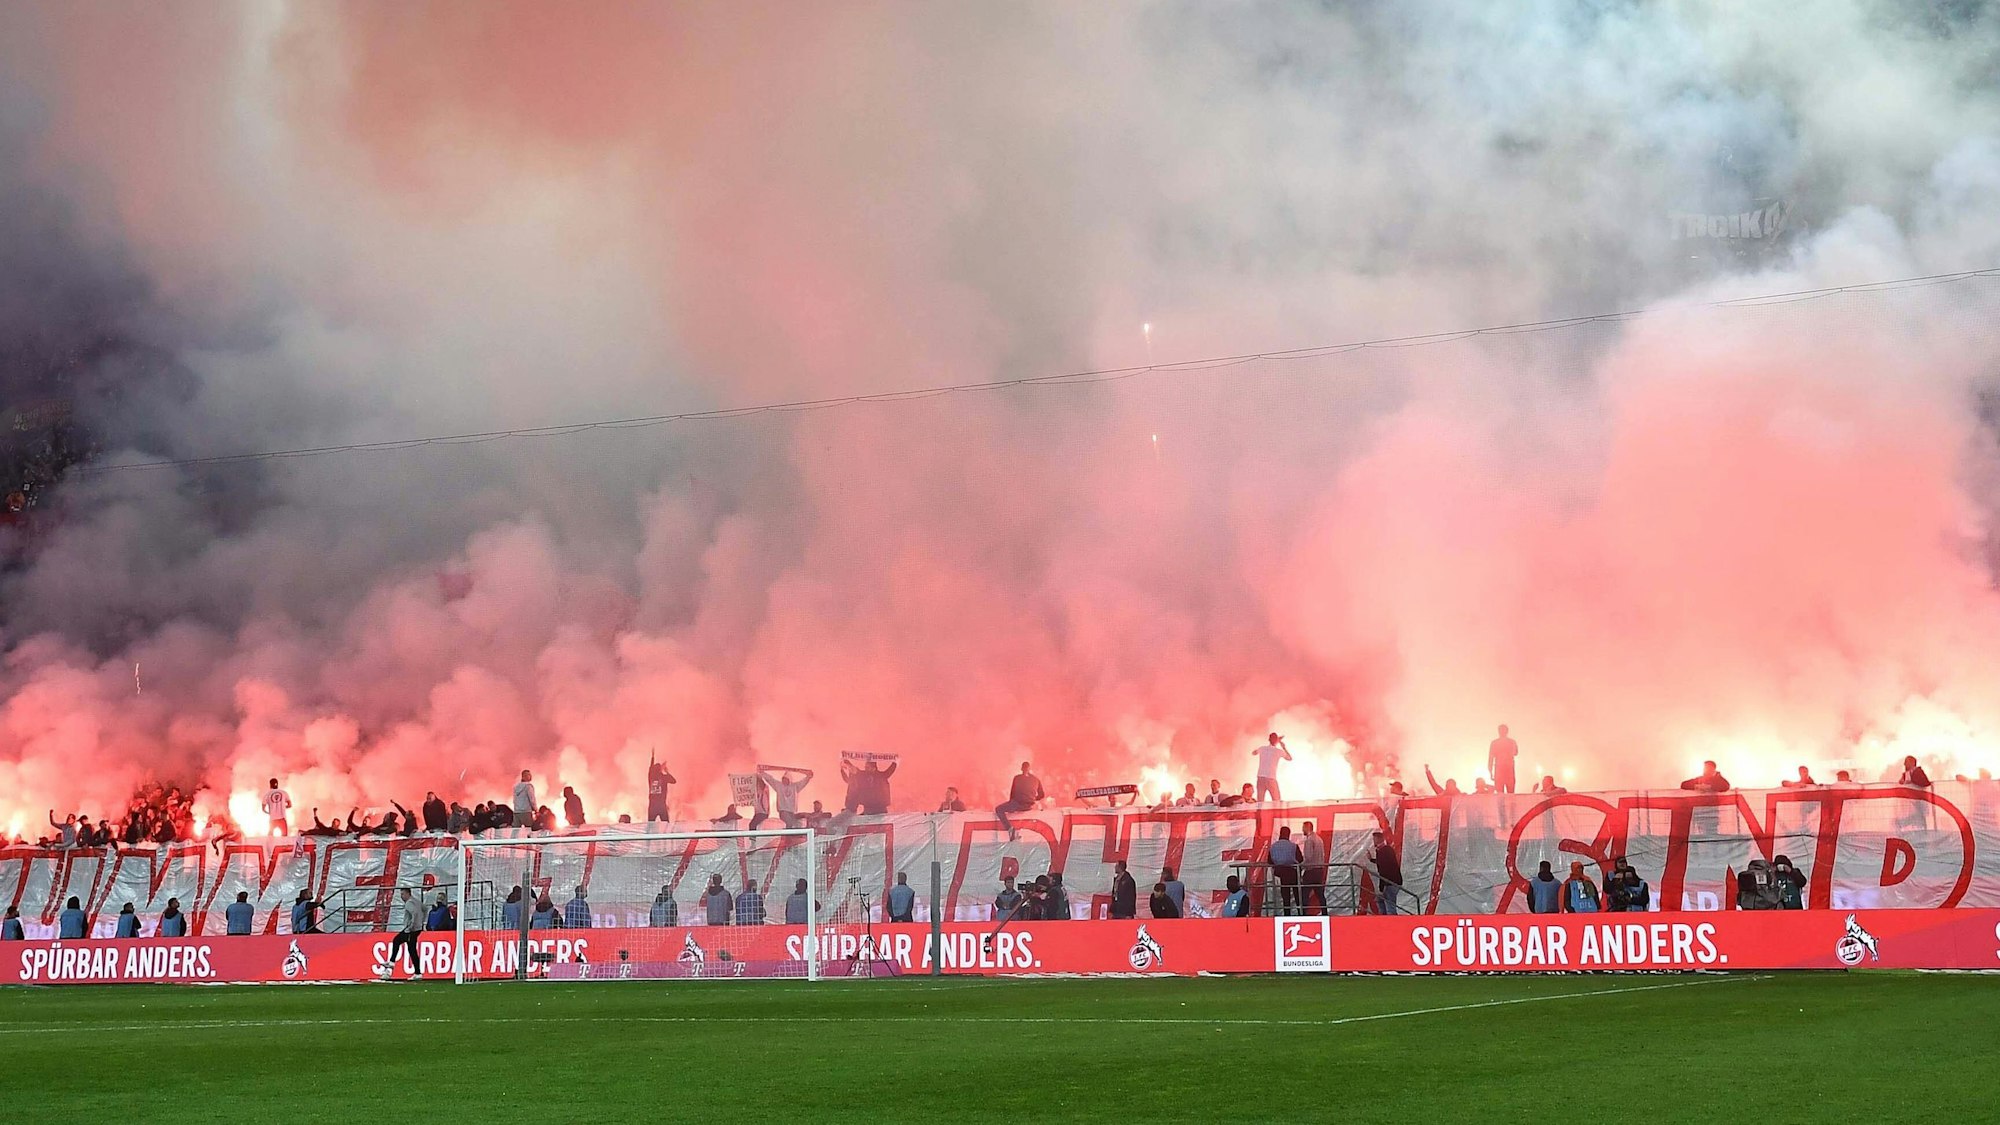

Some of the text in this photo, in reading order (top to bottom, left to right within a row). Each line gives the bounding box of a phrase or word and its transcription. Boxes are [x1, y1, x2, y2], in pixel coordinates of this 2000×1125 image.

[20, 942, 216, 980] SPÜRBAR ANDERS.
[1411, 919, 1728, 966] SPÜRBAR ANDERS.
